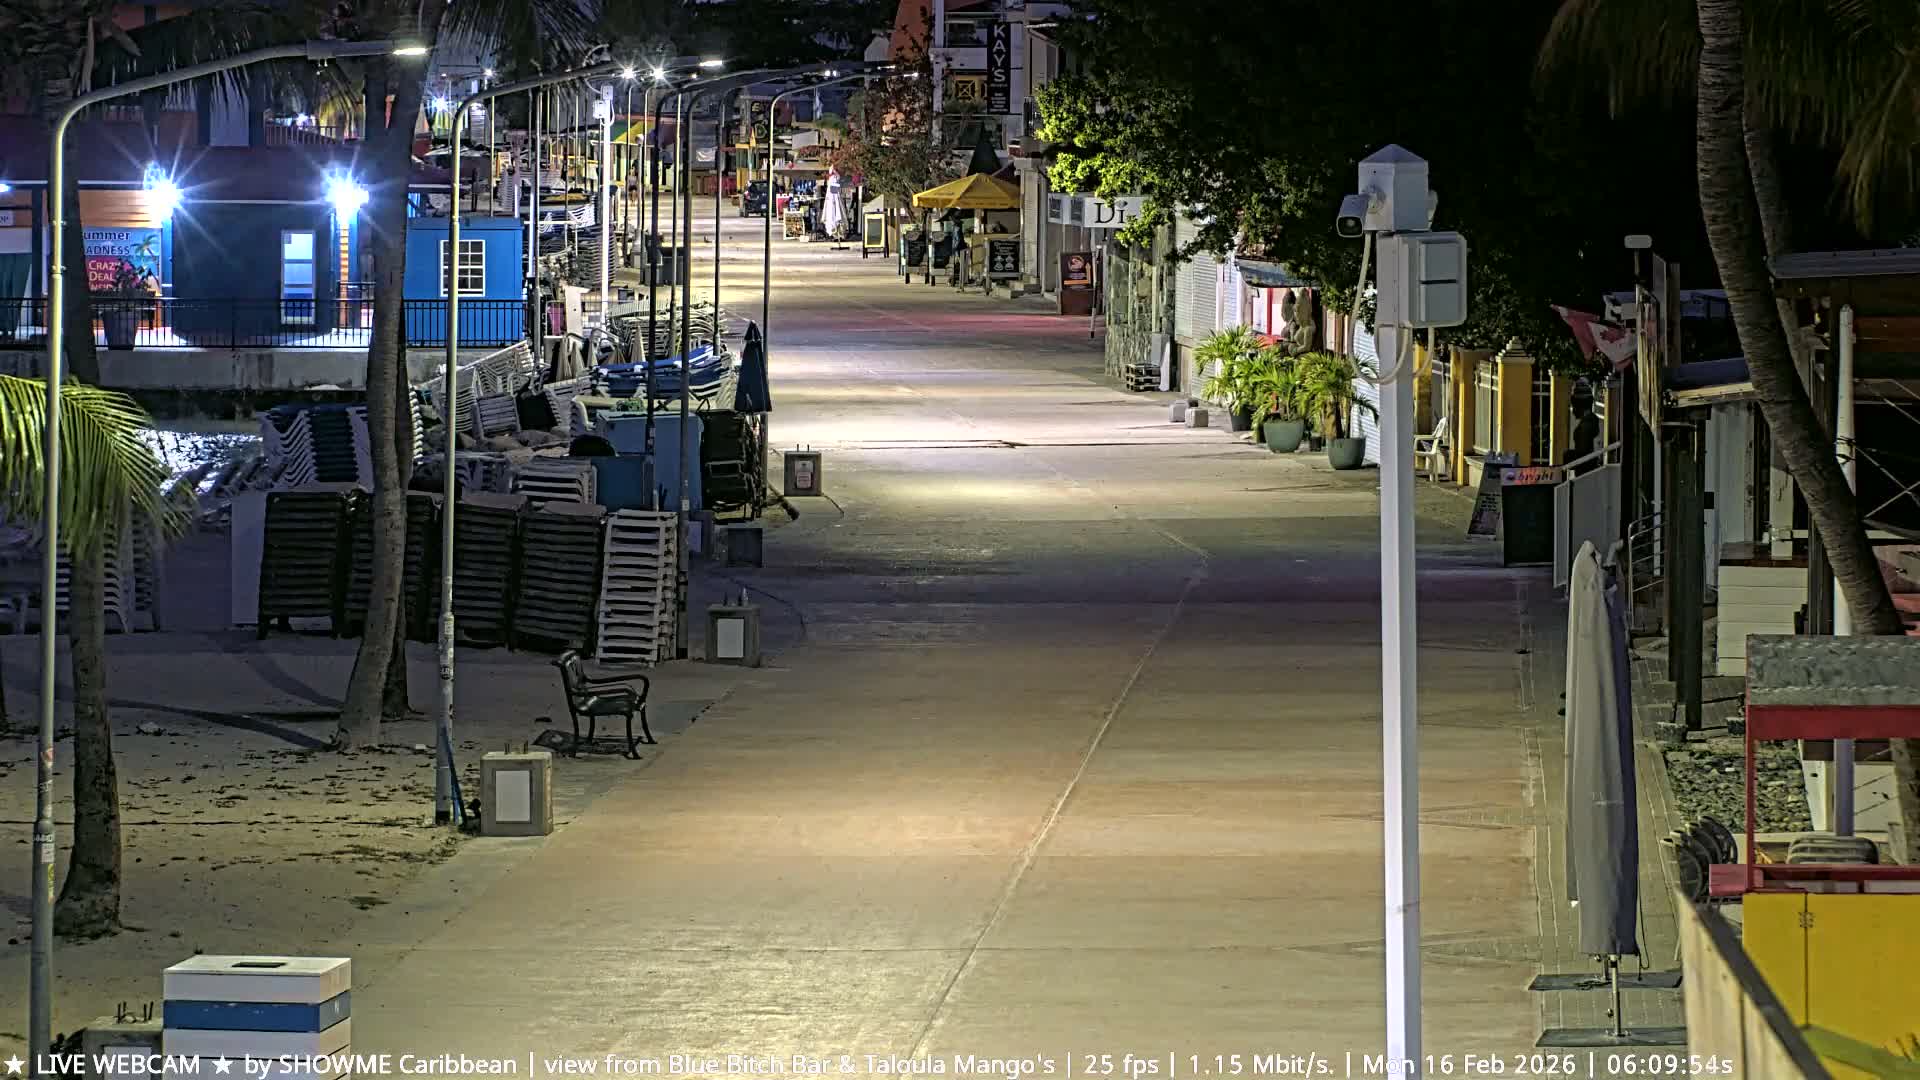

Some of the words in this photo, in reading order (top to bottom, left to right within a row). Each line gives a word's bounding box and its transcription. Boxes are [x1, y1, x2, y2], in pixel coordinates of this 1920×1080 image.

[992, 24, 1007, 83] KAY'S
[83, 231, 131, 241] ummer
[86, 245, 130, 255] ADNESS
